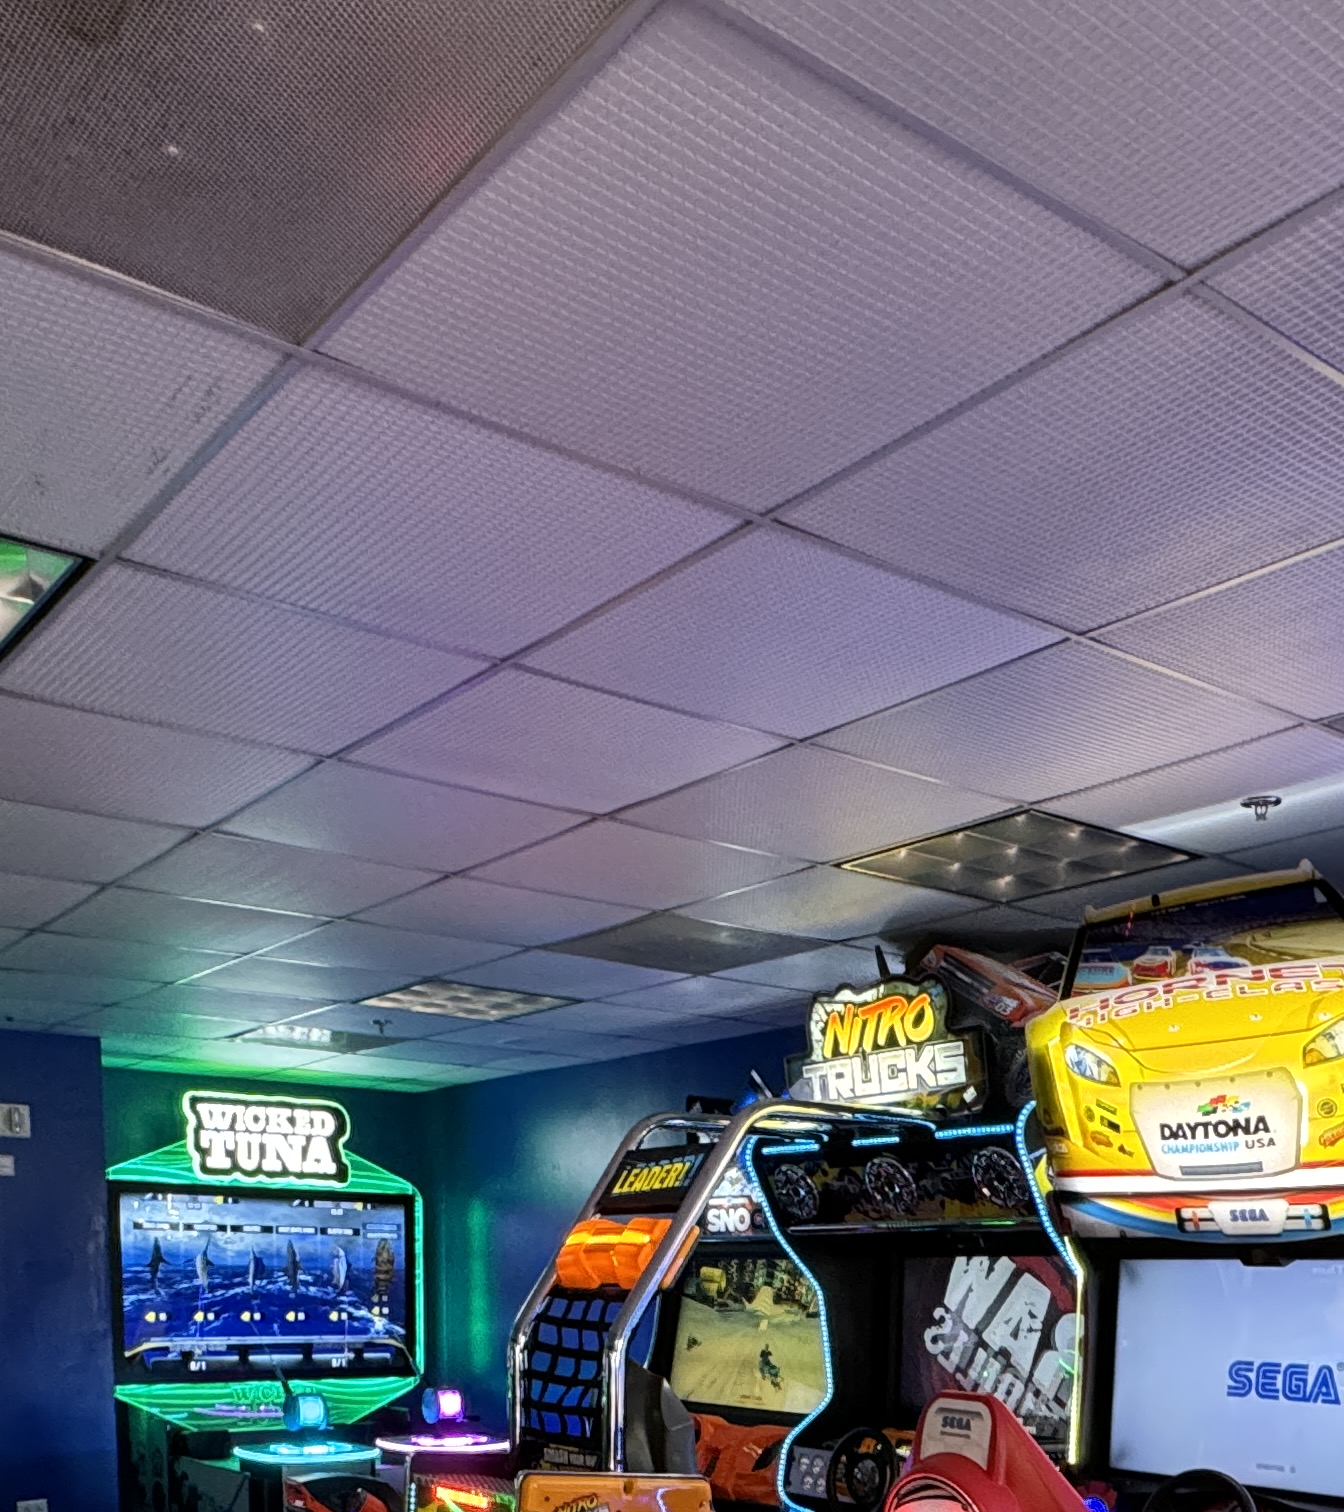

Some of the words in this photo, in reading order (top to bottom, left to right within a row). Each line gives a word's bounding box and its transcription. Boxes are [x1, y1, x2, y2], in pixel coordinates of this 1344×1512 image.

[821, 992, 936, 1058] NITRO
[801, 1040, 968, 1103] TRUCKS
[195, 1101, 337, 1138] WICKED
[1158, 1114, 1273, 1142] DAYTONA
[200, 1130, 338, 1176] TUNA
[1160, 1140, 1240, 1155] CHAMPIONSHIP
[1244, 1137, 1277, 1150] USA
[609, 1160, 692, 1196] LEADER!
[1229, 1208, 1270, 1223] SEGA
[1226, 1359, 1342, 1405] SEGA
[940, 1415, 972, 1432] SEGA
